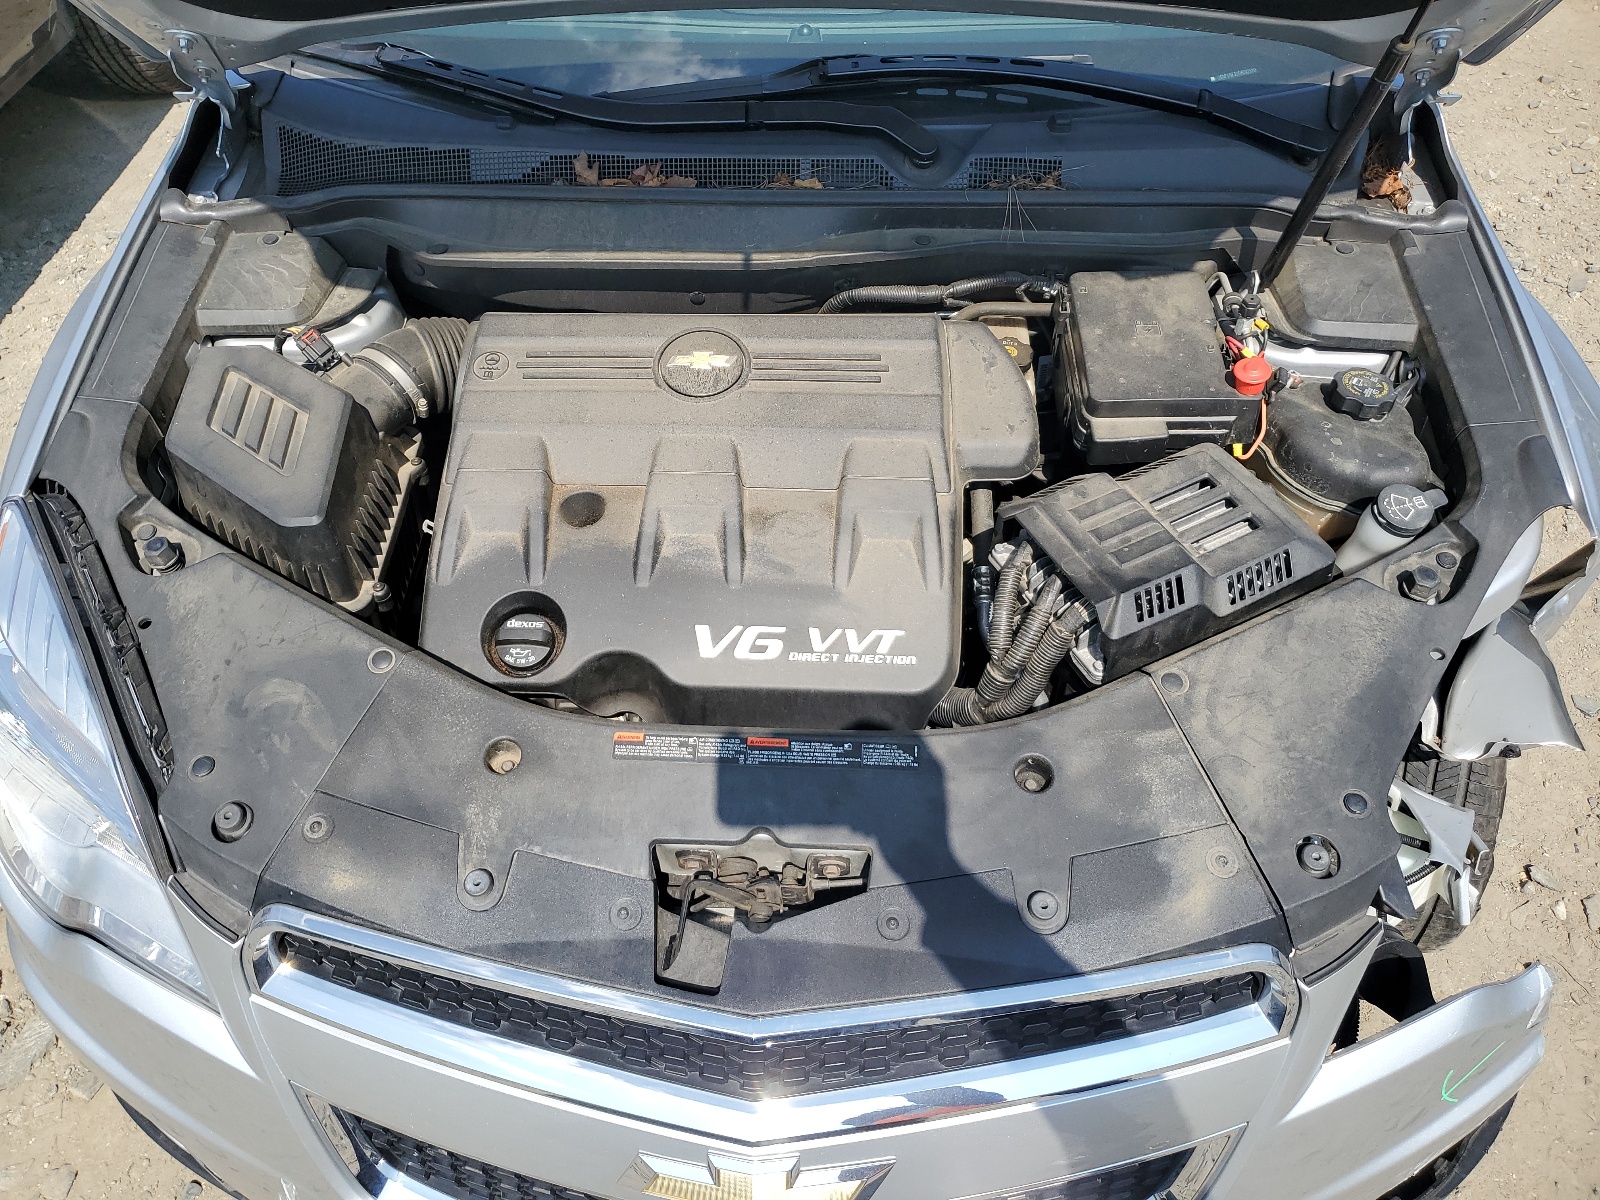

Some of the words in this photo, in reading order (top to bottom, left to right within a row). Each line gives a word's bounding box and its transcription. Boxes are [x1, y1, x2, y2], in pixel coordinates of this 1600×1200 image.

[506, 619, 545, 628] dexos
[694, 624, 787, 660] V6
[808, 627, 906, 654] VVT
[788, 652, 840, 663] DIRECT
[844, 653, 918, 665] INJECTION
